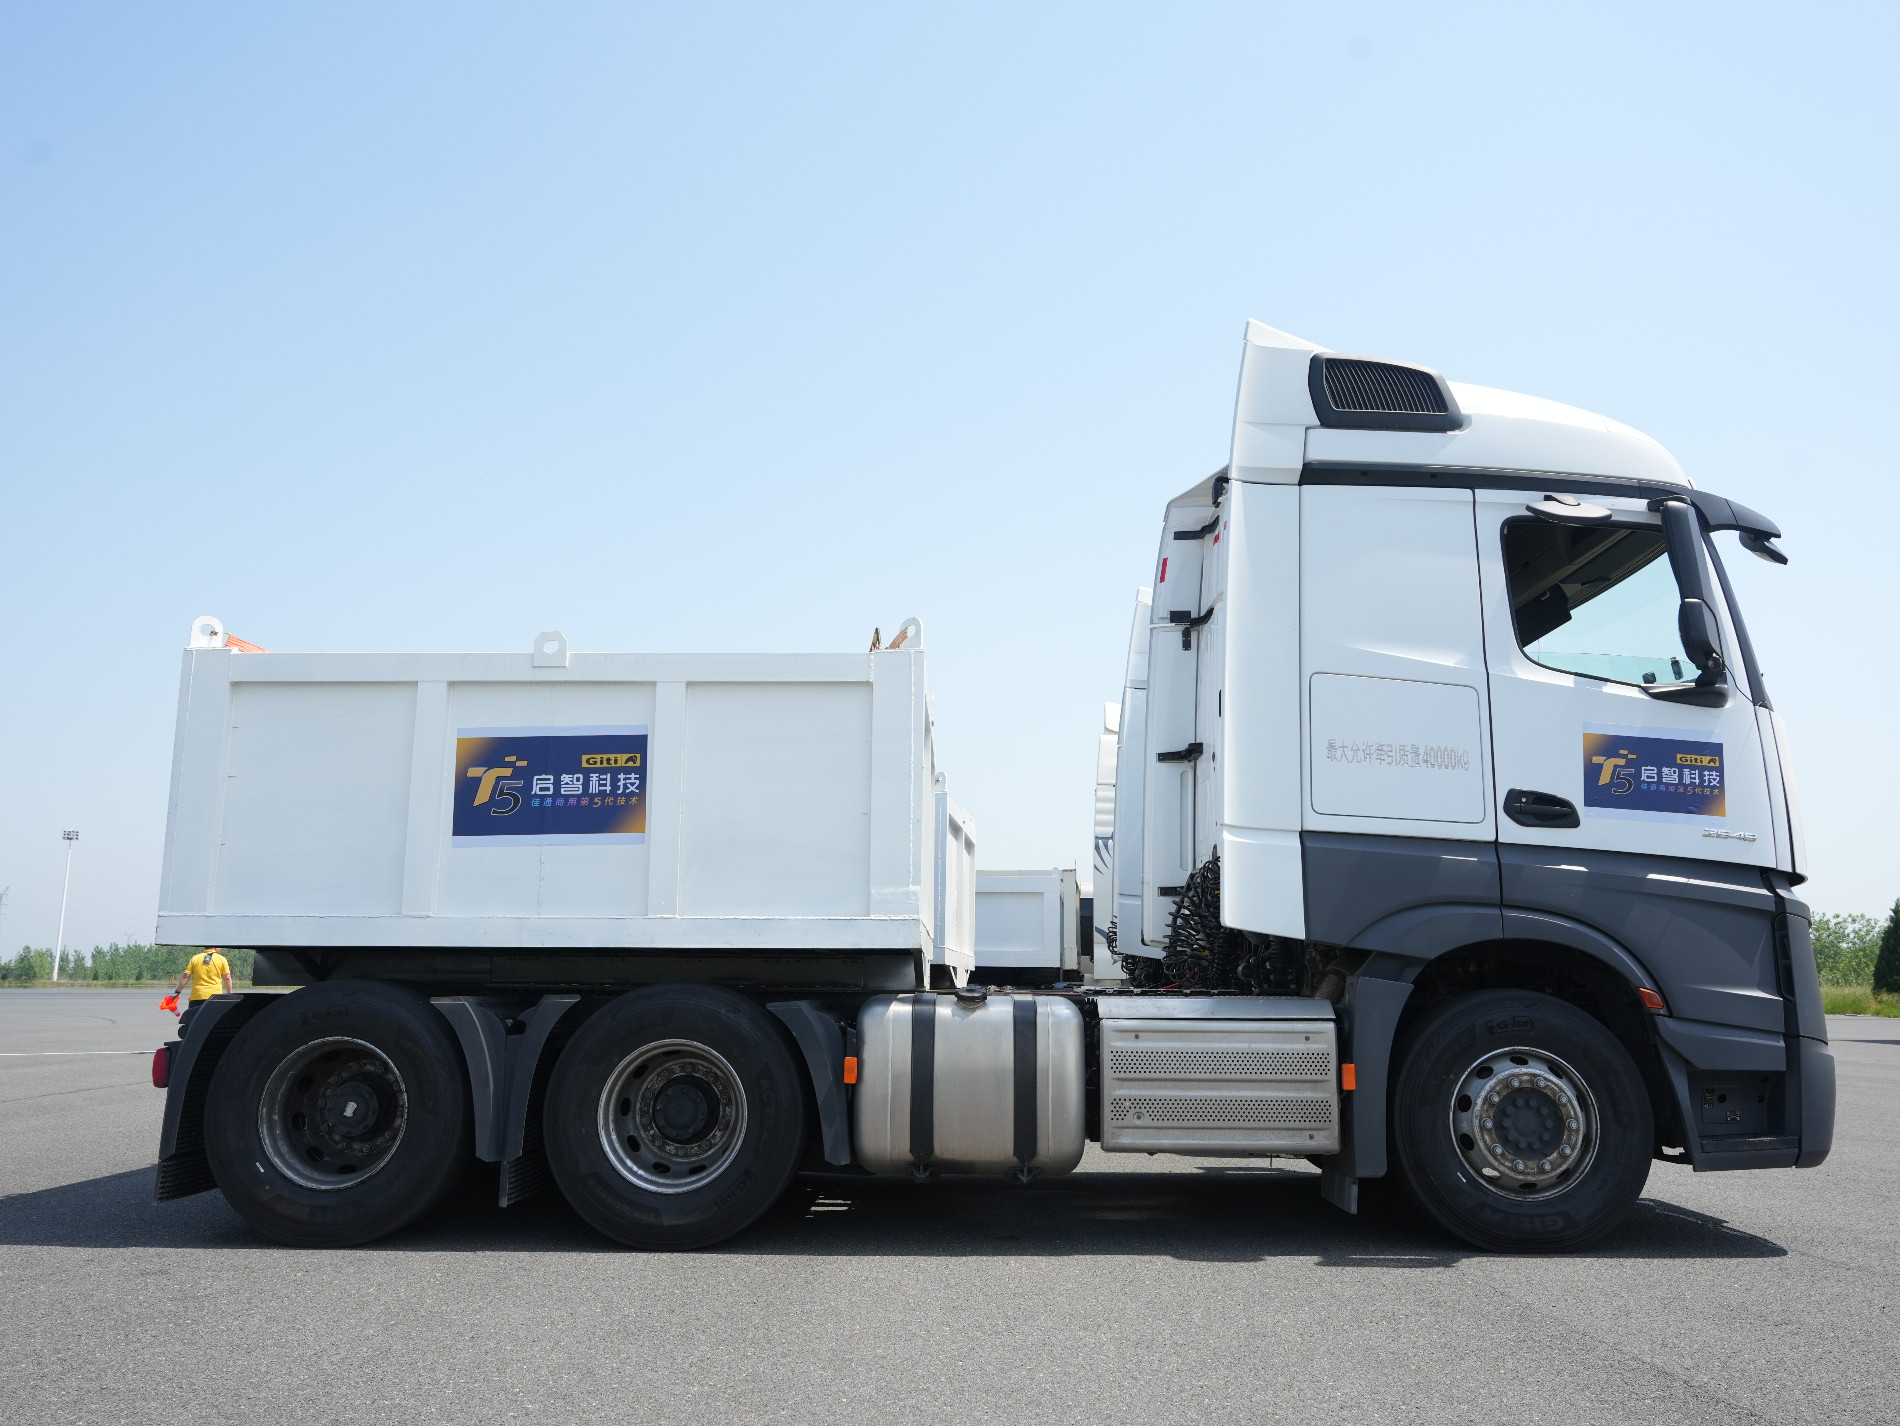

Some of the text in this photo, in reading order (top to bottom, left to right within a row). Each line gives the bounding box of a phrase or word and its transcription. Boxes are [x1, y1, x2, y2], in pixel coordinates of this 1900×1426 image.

[585, 756, 619, 766] Giti
[1679, 756, 1704, 765] Giti
[1640, 765, 1720, 787] 启智科技
[531, 773, 640, 795] 启智科技
[531, 796, 639, 808] 佳通商用第5代技术
